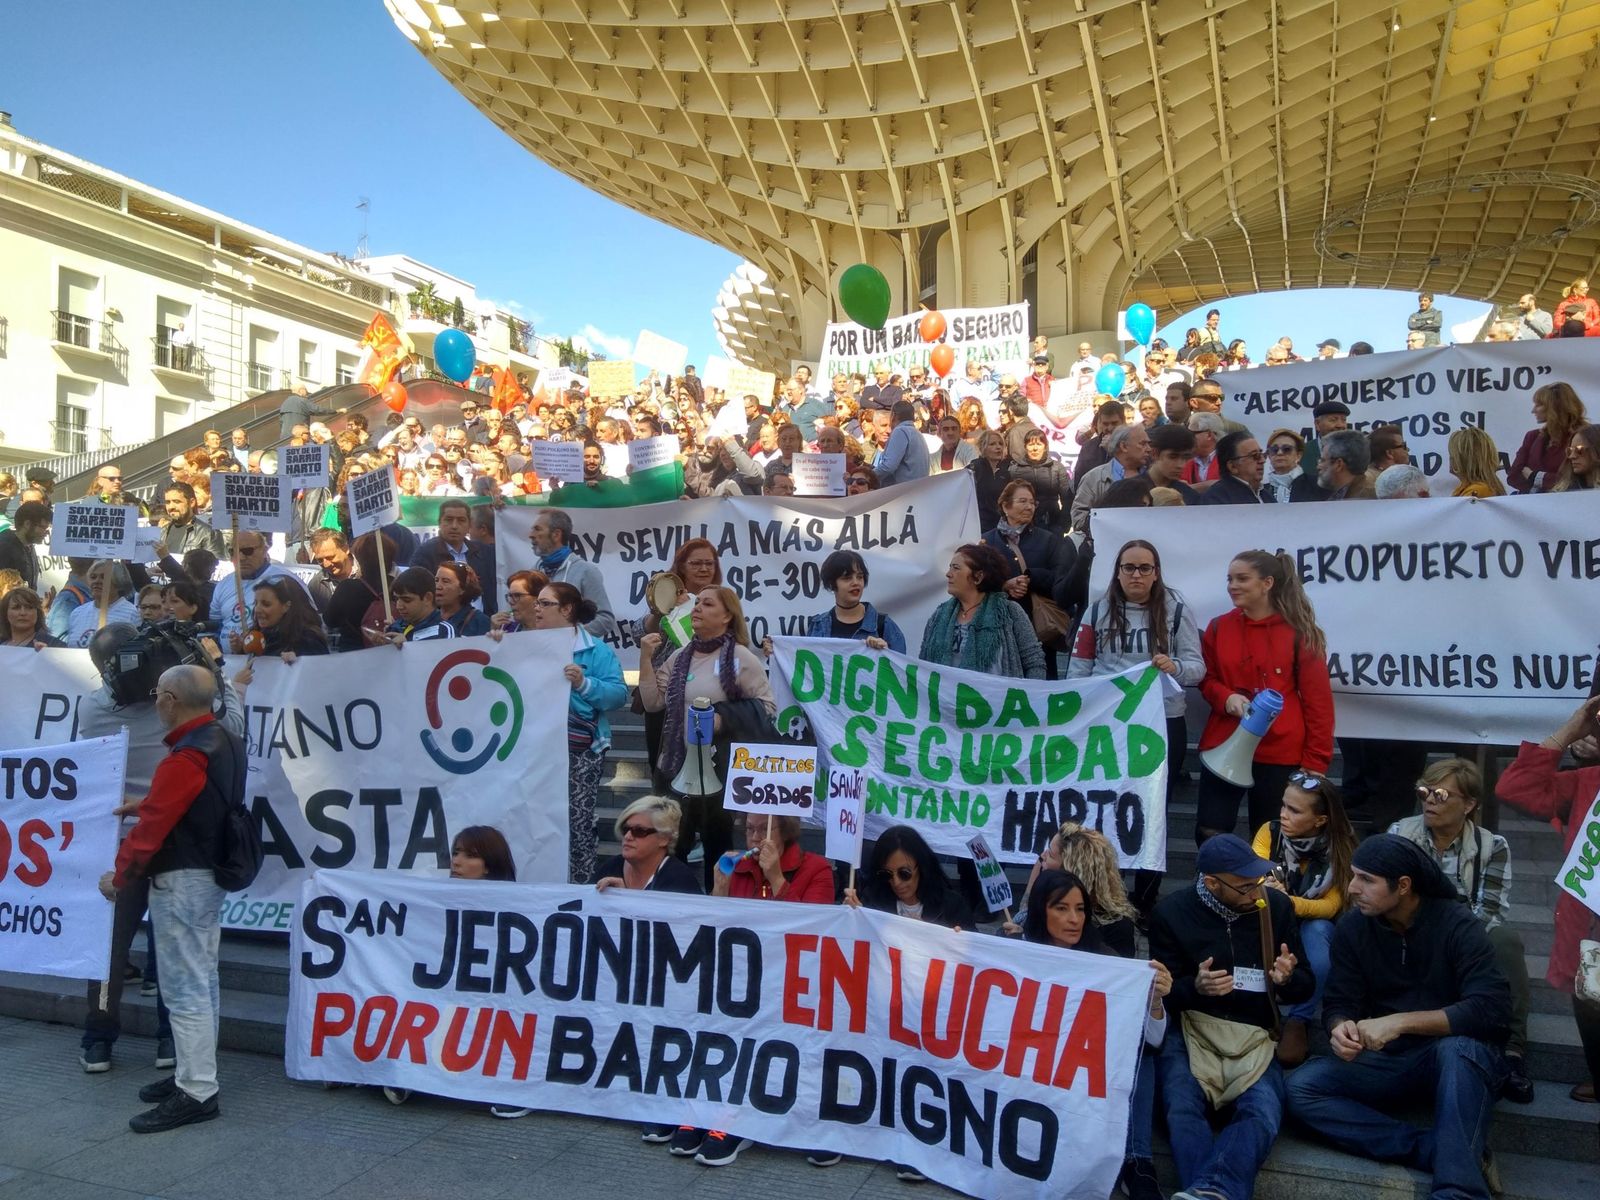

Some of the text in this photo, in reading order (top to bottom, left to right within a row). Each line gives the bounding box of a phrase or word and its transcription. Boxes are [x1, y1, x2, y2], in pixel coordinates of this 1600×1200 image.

[830, 310, 1023, 356] POR UN BARO SEGURO
[286, 453, 321, 464] BARRIO
[286, 462, 321, 475] HARTO
[225, 475, 279, 486] SOY DE UN
[225, 485, 279, 498] BARRIO
[352, 468, 388, 490] SOY DE UN
[353, 477, 391, 501] BARRIO
[67, 515, 125, 527] BARRIO
[68, 506, 125, 517] SOY DE UN
[226, 497, 279, 512] HARTO
[355, 489, 393, 515] HARTO
[66, 526, 124, 540] HARTO
[569, 533, 605, 563] AY
[749, 518, 824, 555] MÁS
[834, 506, 919, 550] ALLÁ
[1254, 540, 1524, 584] EROPUERTO
[728, 561, 820, 602] SE-30
[1328, 644, 1599, 690] ARGINÉIS NUE
[792, 649, 1159, 730] DIGNIDAD Y
[244, 699, 382, 760] TANO
[831, 715, 1166, 785] SEGURIDAD
[1, 757, 79, 801] TOS
[732, 776, 814, 809] SORDOS
[866, 777, 990, 828] ONTANO
[253, 786, 451, 870] ASTA
[219, 893, 295, 929] RÓSPE
[301, 895, 1107, 1098] SAN JERÓNIMO EN LUCHA
[310, 992, 1059, 1181] POR UN BARRIO DIGNO
